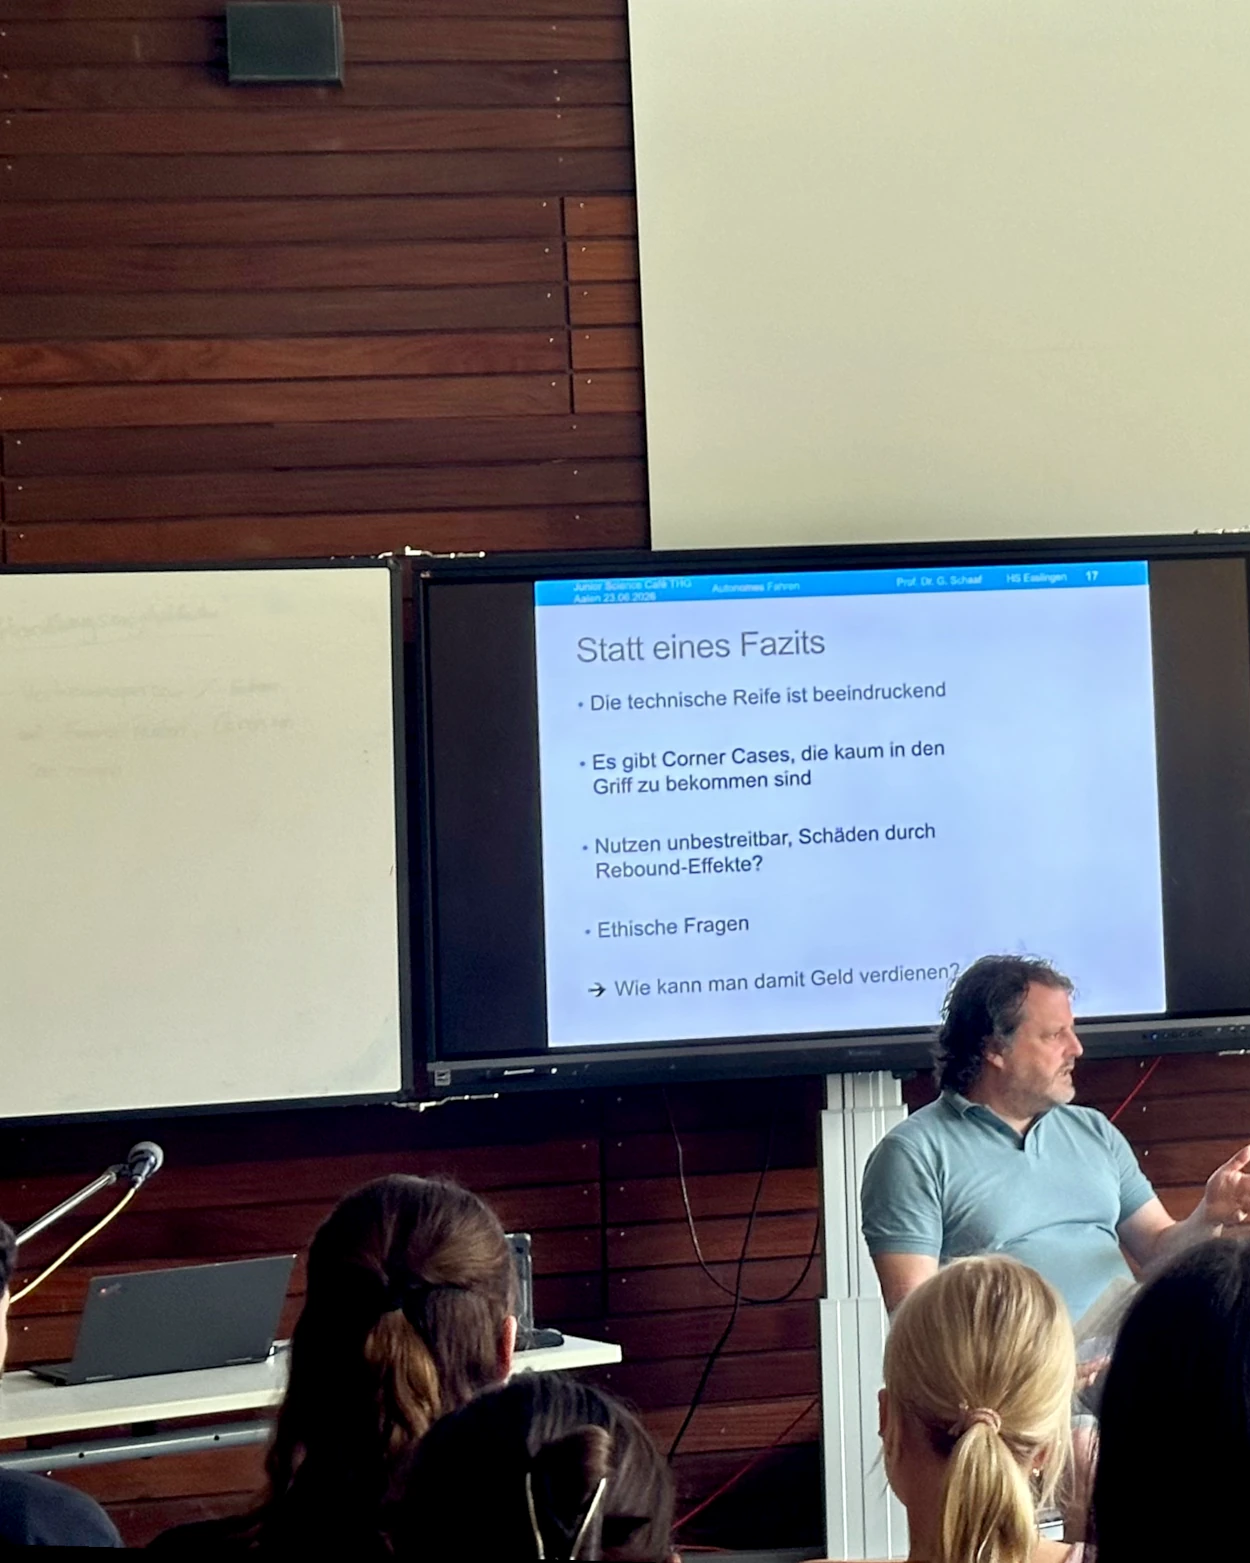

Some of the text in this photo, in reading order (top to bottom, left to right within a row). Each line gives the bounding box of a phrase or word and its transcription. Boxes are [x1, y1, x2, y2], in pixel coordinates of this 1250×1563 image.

[1006, 574, 1021, 583] HS
[1086, 570, 1099, 581] 17
[576, 630, 826, 663] Statt eines Fazits
[590, 682, 946, 712] Die technische Reife ist beeindruckend
[592, 740, 945, 774] Es gibt Corner Cases, die kaum in den
[593, 770, 812, 795] Griff zu bekommen sind
[595, 823, 936, 855] Nutzen unbestreitbar, Schäden durch
[595, 855, 764, 880] Rebound-Effekte?
[597, 915, 750, 939] Ethische Fragen
[614, 962, 960, 998] Wie kann man damit Geld verdienen?
